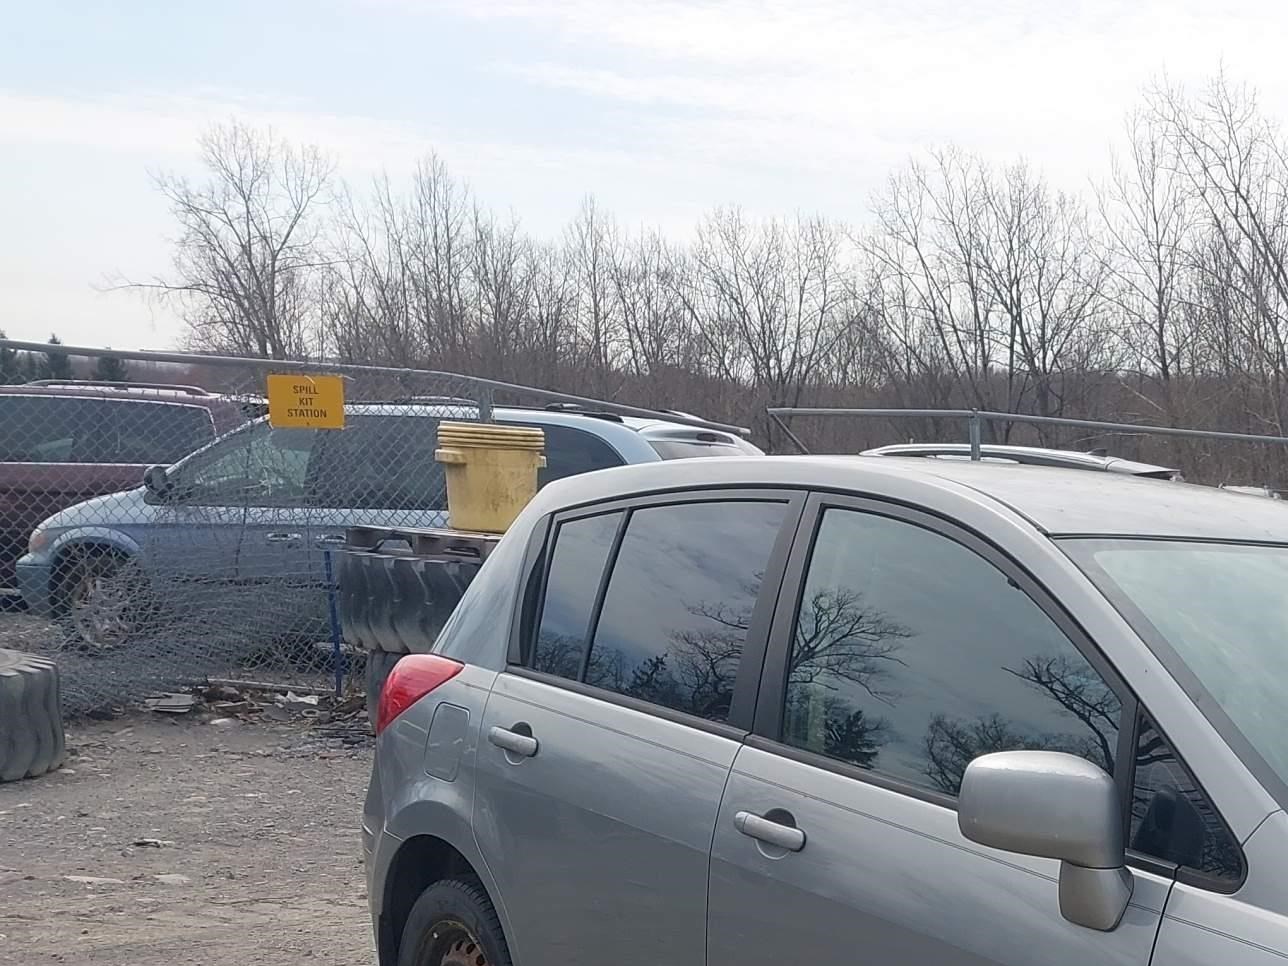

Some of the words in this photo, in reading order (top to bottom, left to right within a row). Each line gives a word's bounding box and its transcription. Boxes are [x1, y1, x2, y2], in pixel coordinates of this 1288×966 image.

[292, 384, 320, 395] SPILL
[298, 397, 314, 406] KIT
[287, 408, 327, 418] STATION
